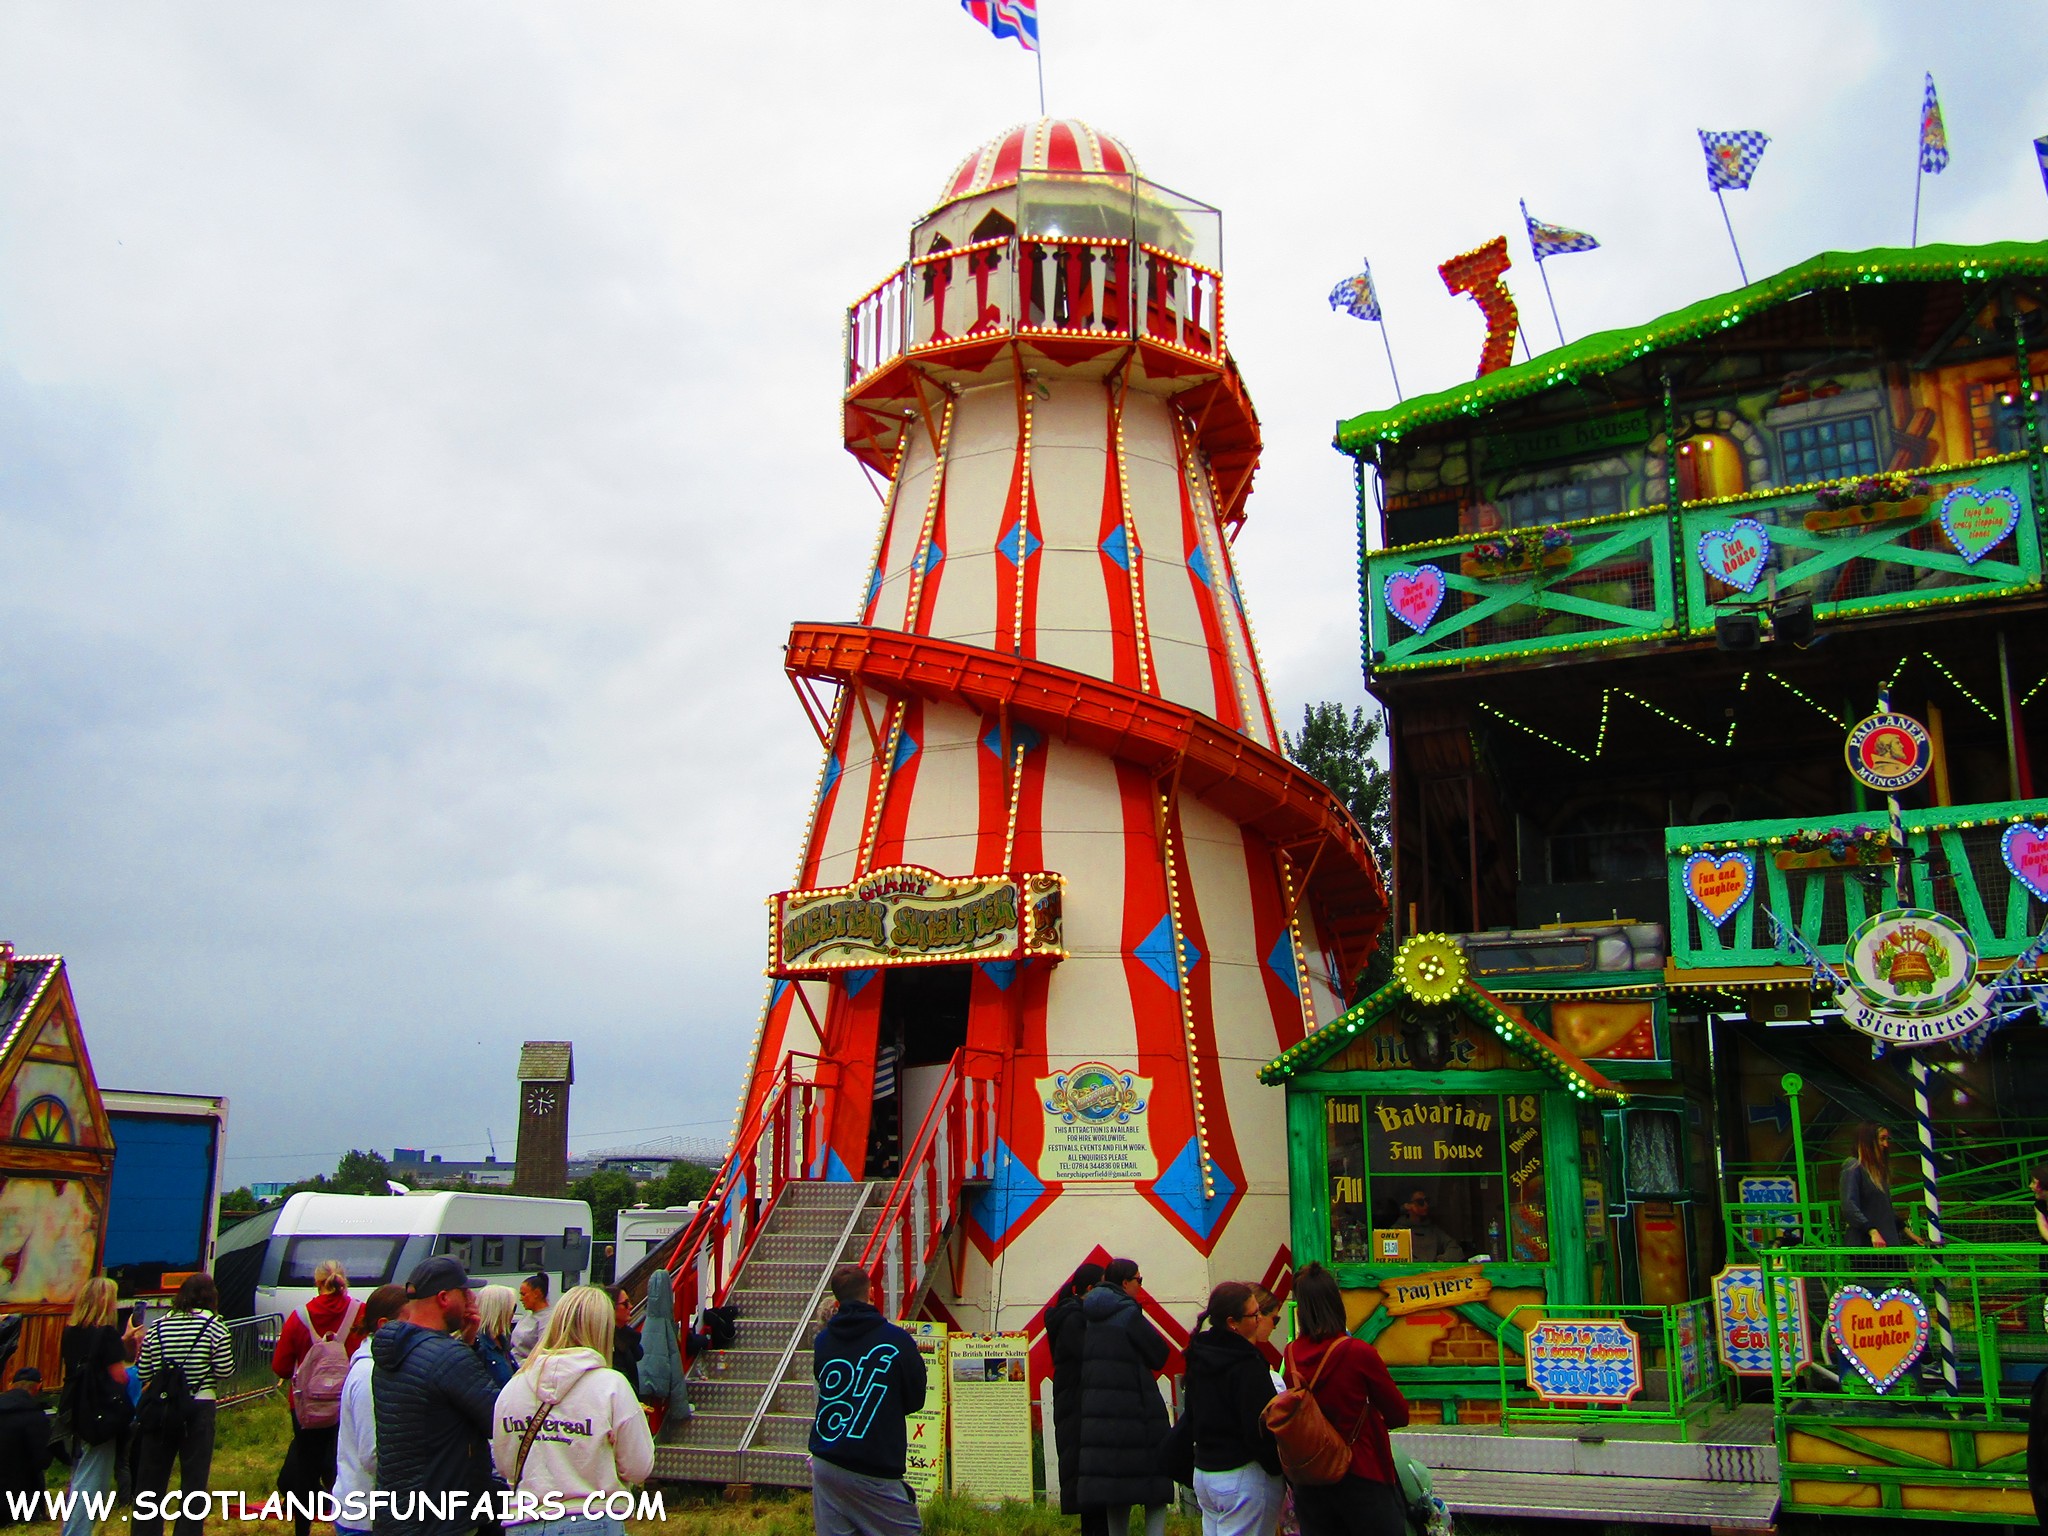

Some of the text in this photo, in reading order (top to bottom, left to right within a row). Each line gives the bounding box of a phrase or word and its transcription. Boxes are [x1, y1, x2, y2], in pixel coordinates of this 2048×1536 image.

[1722, 539, 1743, 559] Fun
[1722, 546, 1756, 575] house
[1850, 716, 1926, 747] PAULANER
[1857, 764, 1923, 787] MÜNCHEN
[859, 871, 932, 900] GIANT
[1698, 868, 1736, 884] Fun and
[1699, 881, 1741, 897] Laughter
[783, 900, 888, 961] HELTER
[892, 884, 1018, 951] SKELTER
[1327, 1098, 1360, 1124] fun
[1374, 1103, 1492, 1132] Bavarian
[1507, 1095, 1537, 1123] 18
[1390, 1140, 1483, 1160] Fun House
[1509, 1127, 1539, 1154] Moving
[1510, 1156, 1541, 1188] Floors
[1332, 1176, 1363, 1204] All
[1433, 1277, 1473, 1297] Here
[1851, 1309, 1903, 1331] Fun and
[1541, 1327, 1620, 1346] This is not
[1853, 1330, 1910, 1350] Laughter
[1536, 1344, 1629, 1363] a scary show
[1548, 1366, 1619, 1393] way in
[503, 1415, 593, 1436] Uniersal
